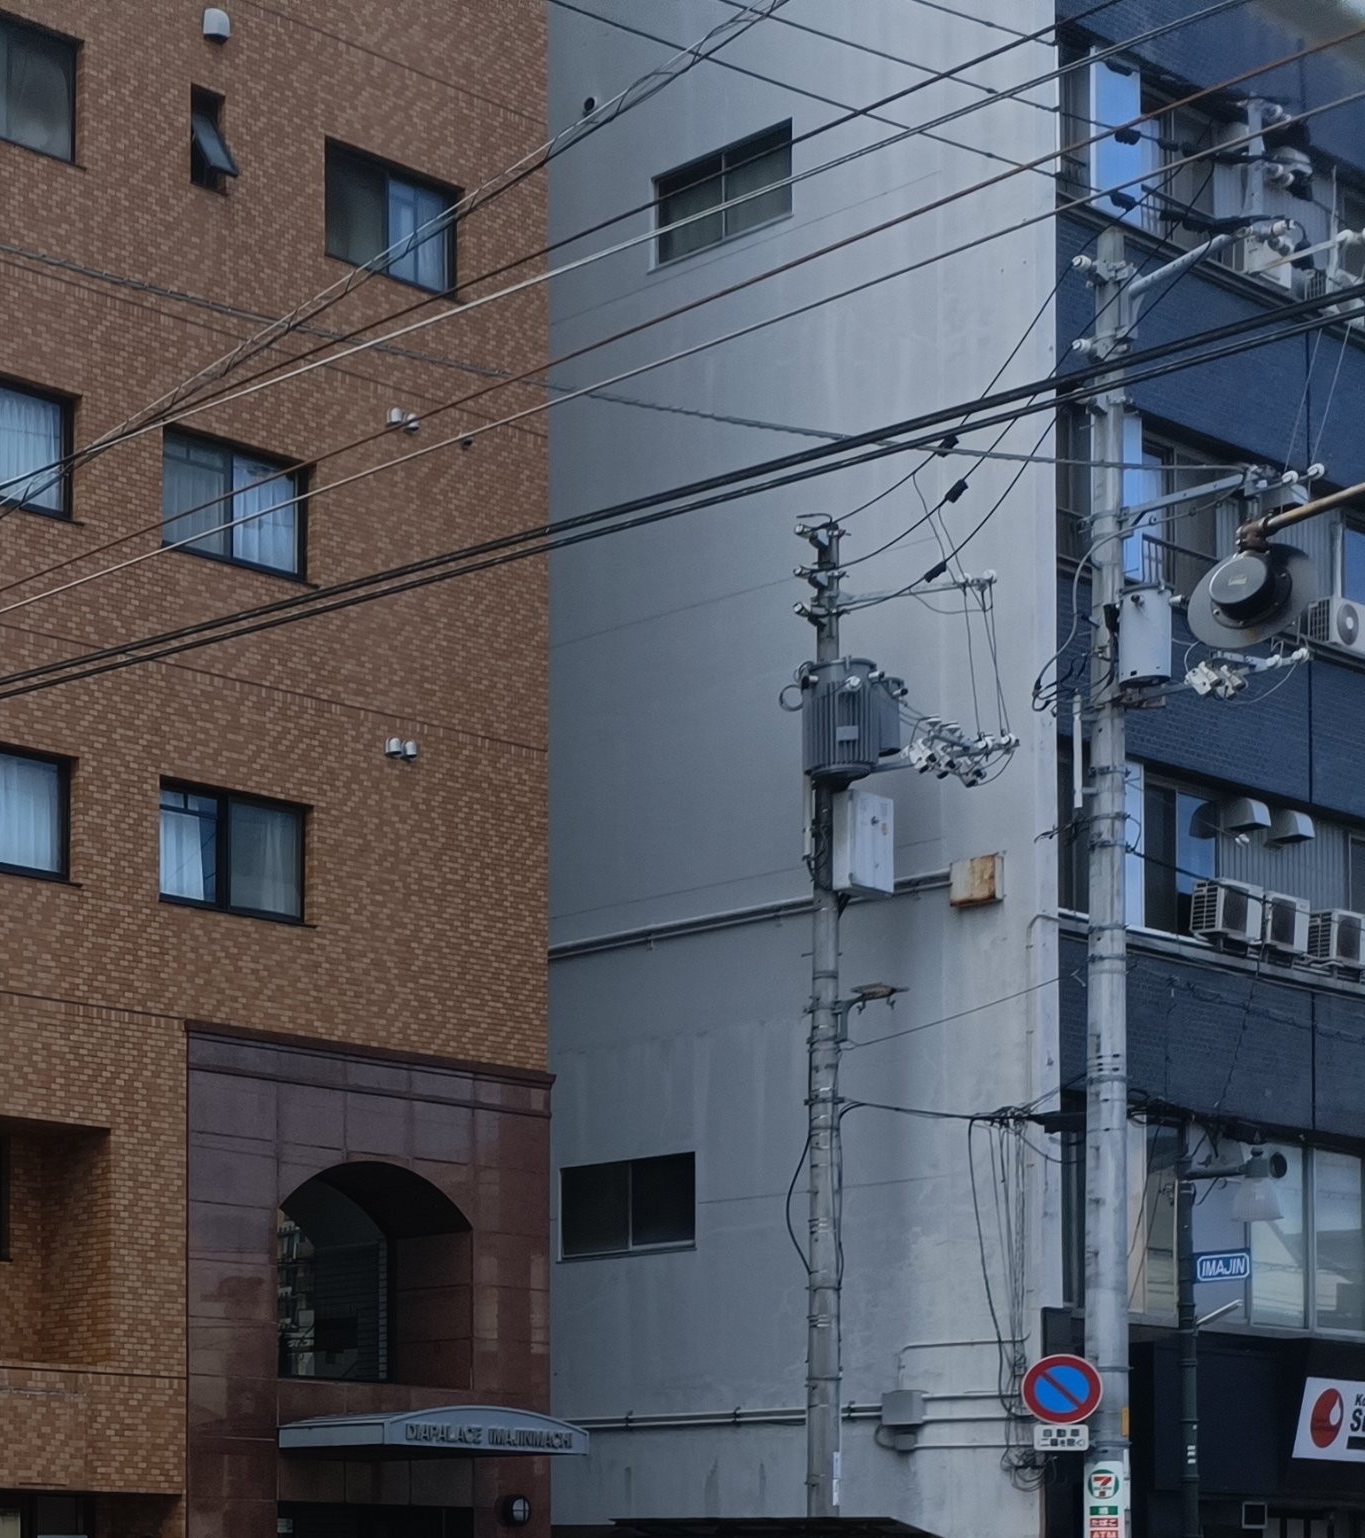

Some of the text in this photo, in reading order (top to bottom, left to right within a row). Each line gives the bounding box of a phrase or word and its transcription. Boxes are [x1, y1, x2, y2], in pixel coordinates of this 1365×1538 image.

[1201, 1257, 1246, 1277] IMAJIN
[405, 1423, 483, 1444] DIAPALACE
[1092, 1531, 1117, 1538] ATM
